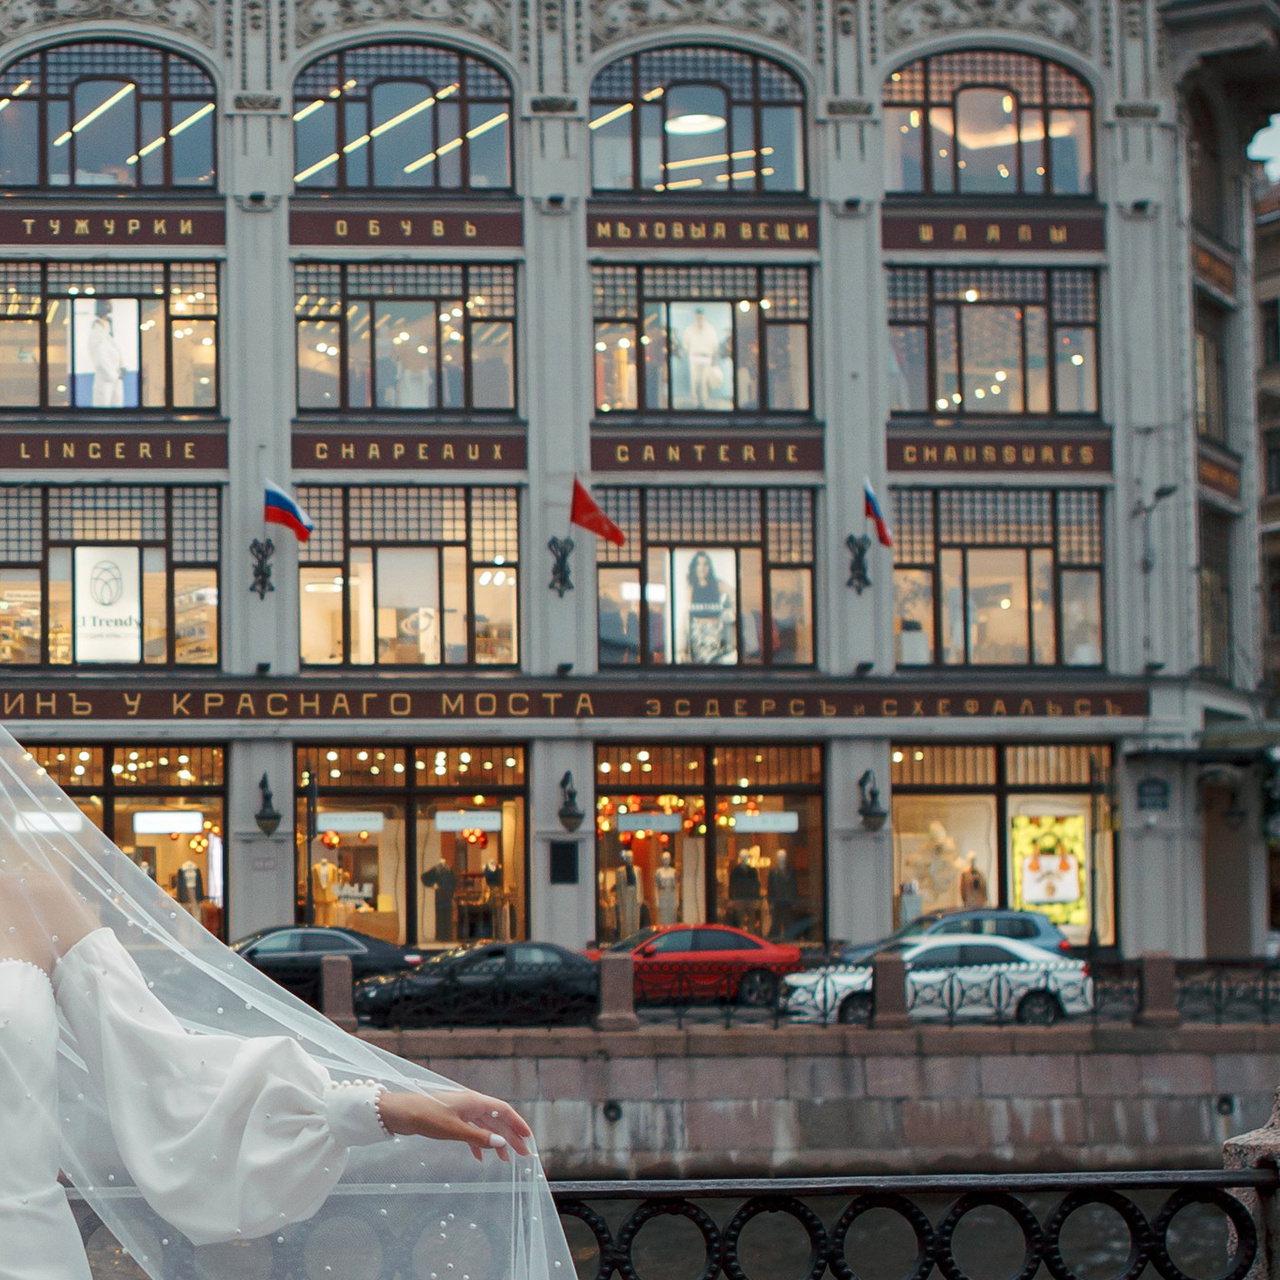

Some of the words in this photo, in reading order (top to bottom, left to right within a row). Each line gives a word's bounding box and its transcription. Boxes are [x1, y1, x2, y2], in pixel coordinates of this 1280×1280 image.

[22, 219, 194, 236] ТУЖУРКИ
[336, 220, 478, 237] ОБУВЬ
[740, 222, 810, 241] ВЕЩИ
[20, 440, 196, 460] LINGERIE
[316, 443, 503, 461] CHAPEAUX
[616, 443, 799, 463] GANTERIE
[904, 446, 1095, 465] CHAUSSURES
[173, 693, 413, 716] КРАСНАГО
[442, 693, 596, 717] МОСТА
[646, 699, 838, 718] ЭСДЕРСЪ
[881, 698, 1124, 717] СХЕФАЛЬСЪ
